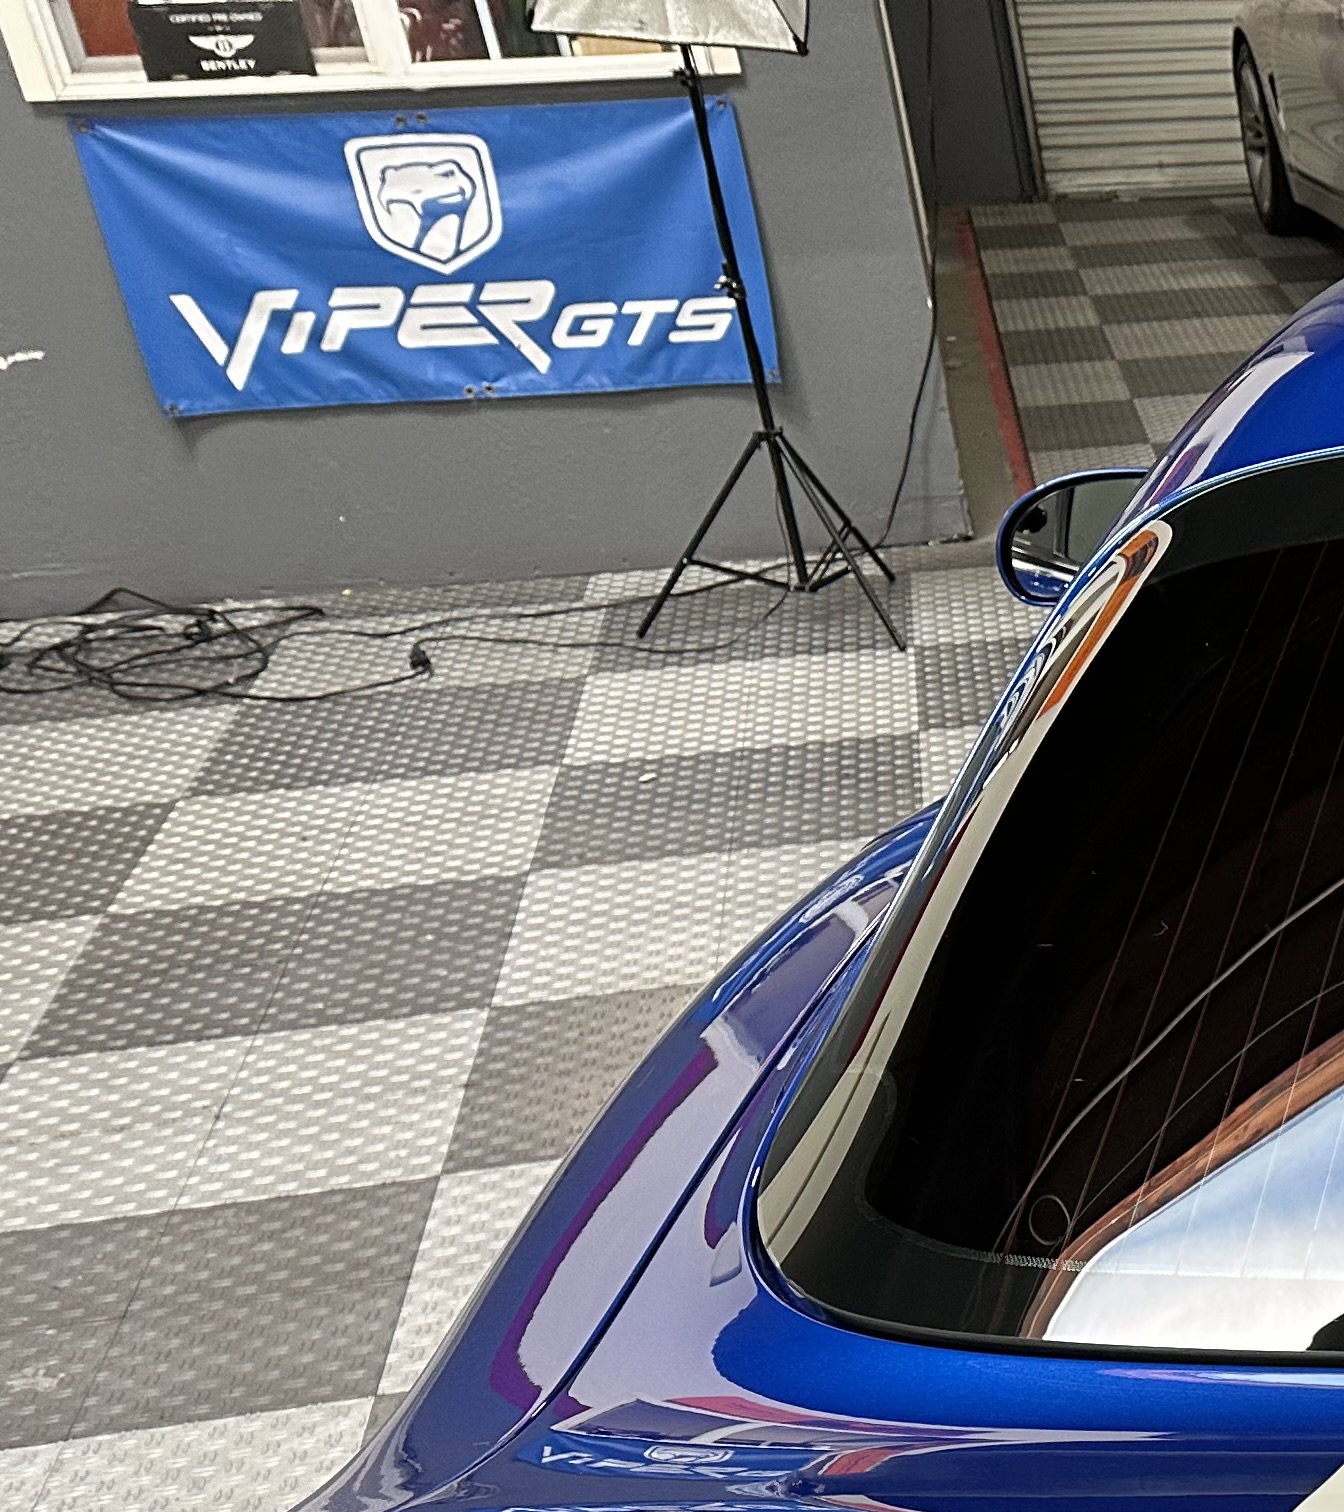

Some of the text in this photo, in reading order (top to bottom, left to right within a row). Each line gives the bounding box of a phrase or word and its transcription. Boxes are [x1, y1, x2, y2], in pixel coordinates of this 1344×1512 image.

[200, 59, 256, 72] BENTLEY
[169, 279, 737, 391] VIPER GTS
